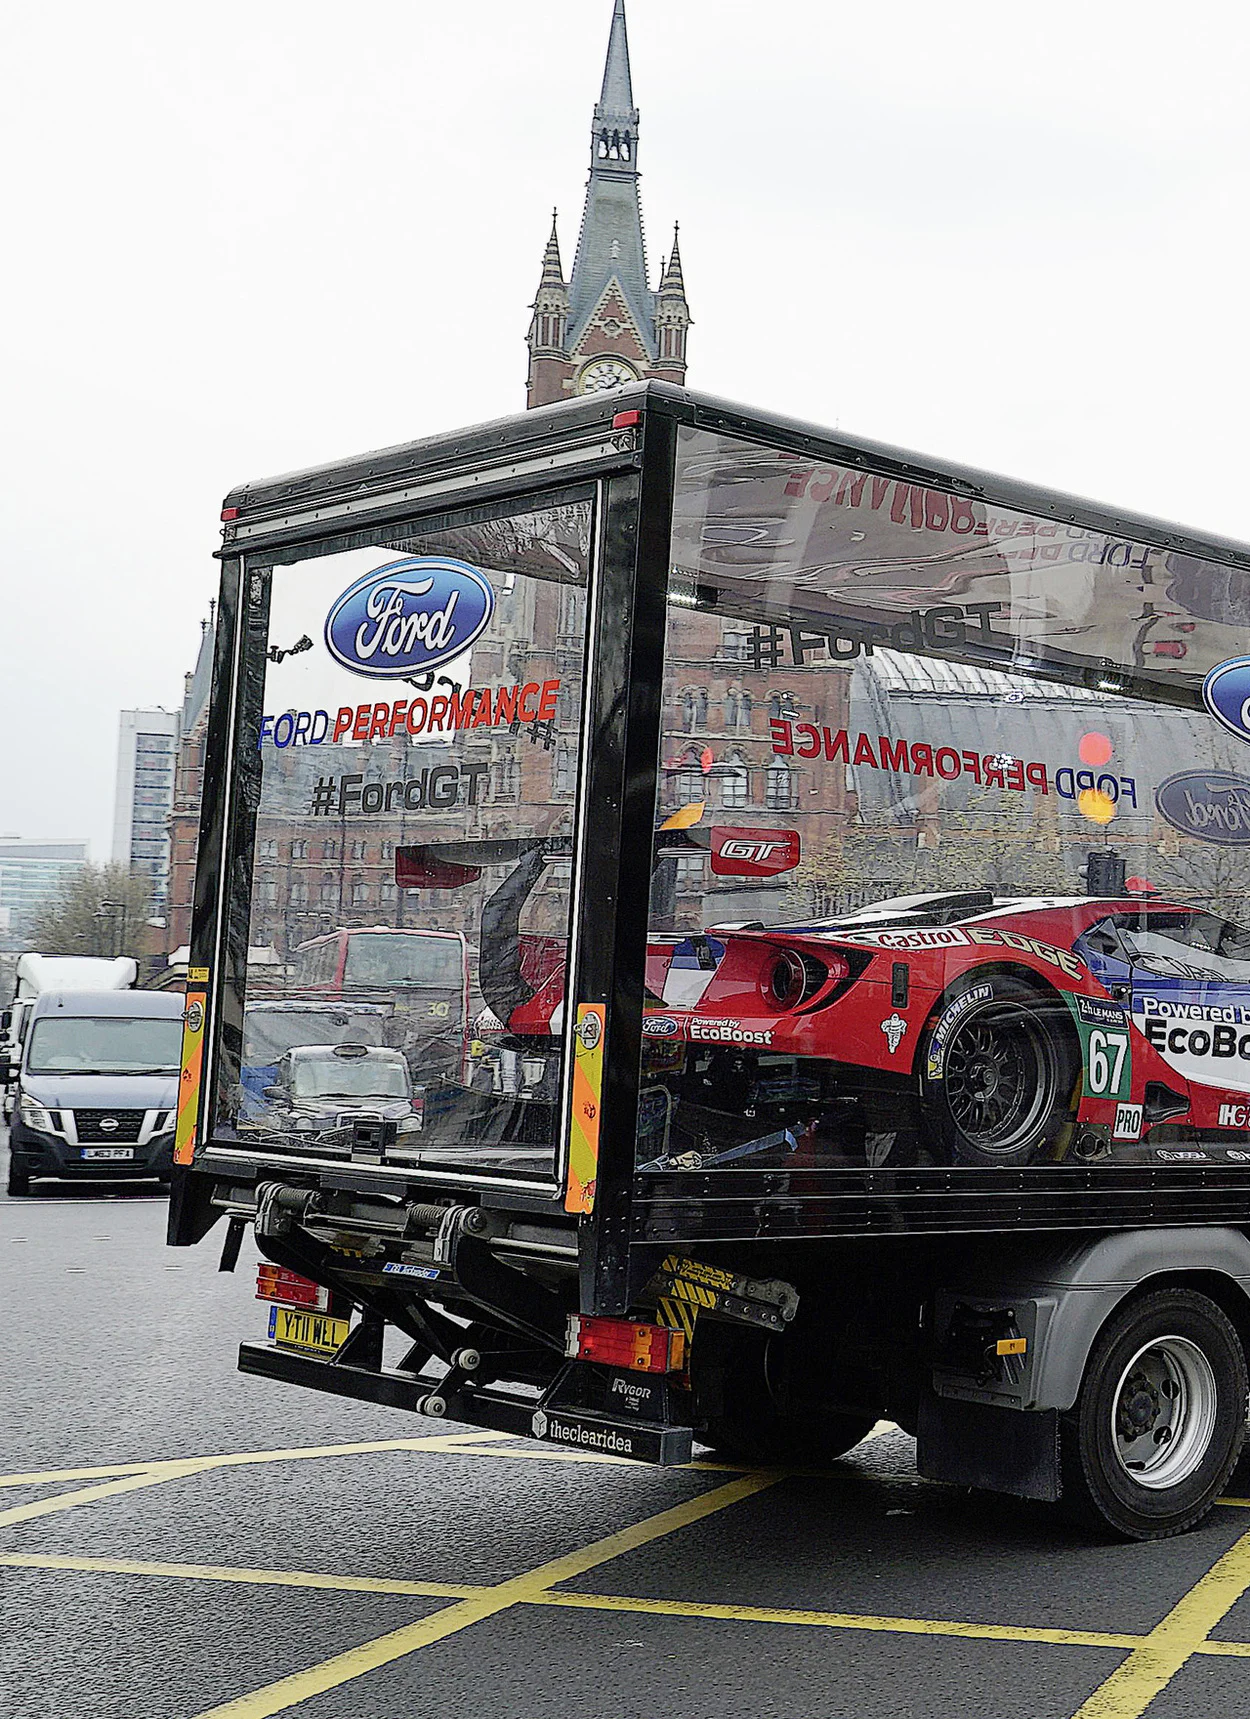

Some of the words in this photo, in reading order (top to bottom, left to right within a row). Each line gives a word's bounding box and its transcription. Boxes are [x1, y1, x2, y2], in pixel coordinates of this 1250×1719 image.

[355, 576, 460, 660] Ford
[748, 602, 1001, 669] #FordGT
[258, 710, 329, 750] FORD
[333, 679, 561, 743] PERFORMANCE
[311, 762, 488, 816] #FordGT
[719, 839, 792, 862] GT
[878, 929, 963, 950] Castrol
[966, 928, 1084, 982] EDGE
[642, 1018, 672, 1033] Ford
[691, 1017, 728, 1028] Powered
[728, 1018, 741, 1029] by
[935, 986, 990, 1044] MICHELIN
[1142, 997, 1240, 1025] Powered
[690, 1025, 774, 1045] EcoBoost
[1089, 1029, 1129, 1094] 67
[1116, 1109, 1141, 1133] PRO
[1218, 1104, 1247, 1127] IHG
[550, 1420, 633, 1453] theclearidea
